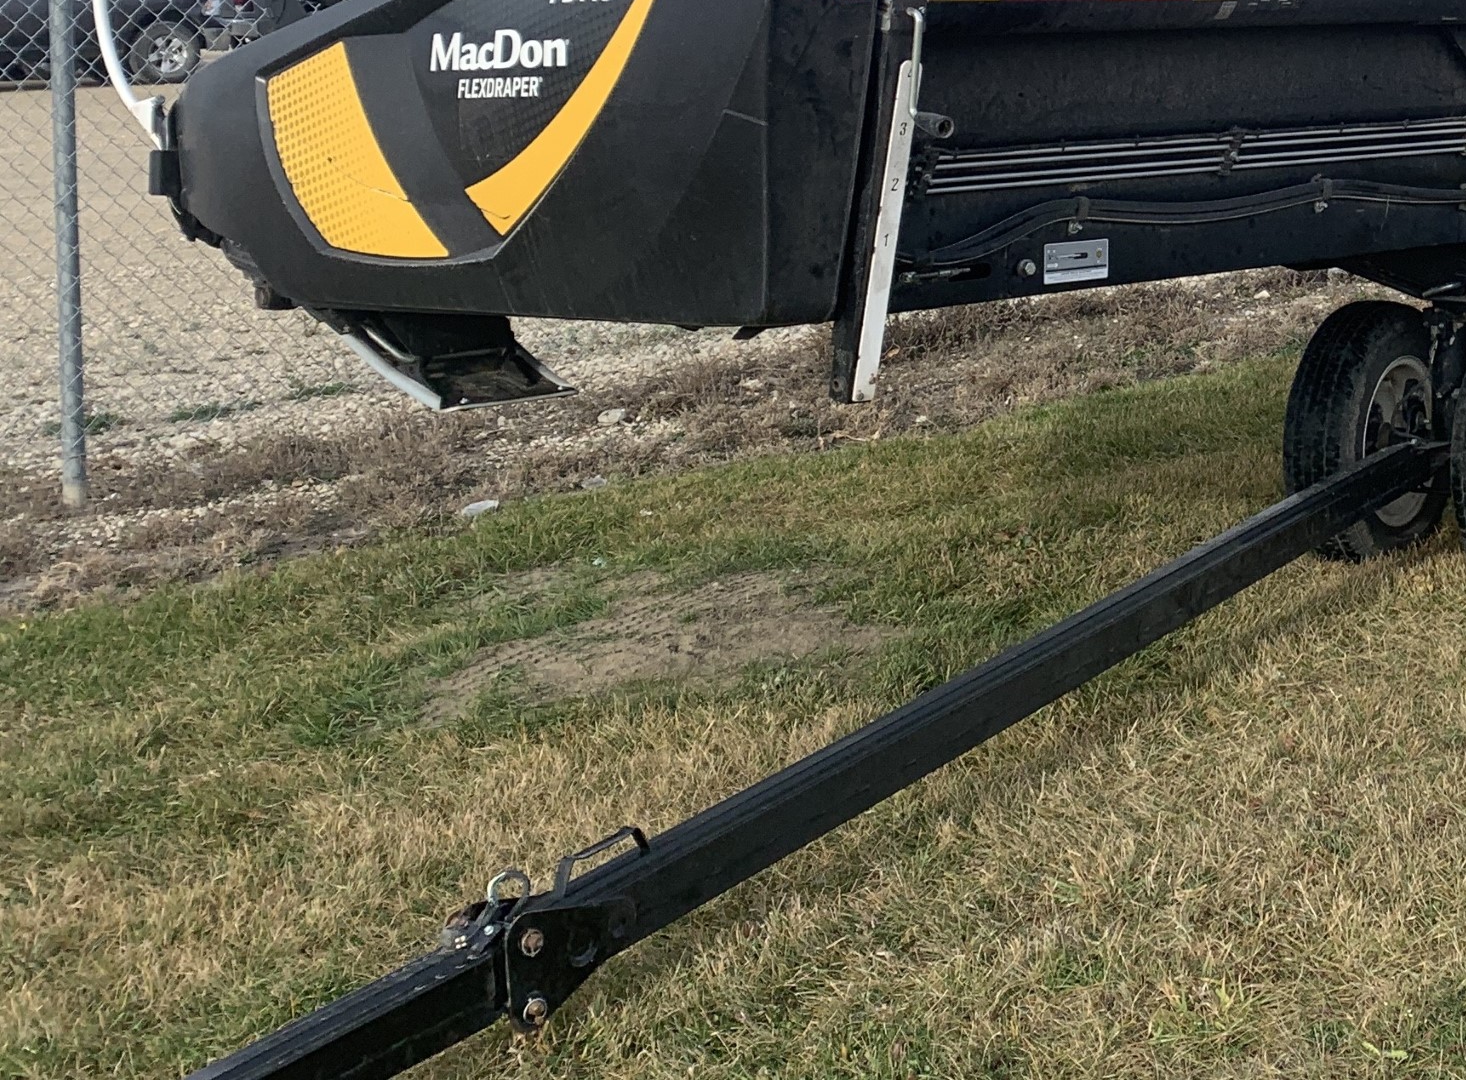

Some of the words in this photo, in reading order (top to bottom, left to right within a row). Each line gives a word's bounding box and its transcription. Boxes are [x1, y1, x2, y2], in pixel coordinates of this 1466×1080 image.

[429, 28, 569, 72] MacDon
[899, 122, 908, 136] 3
[891, 177, 900, 192] 2
[883, 233, 890, 247] 1
